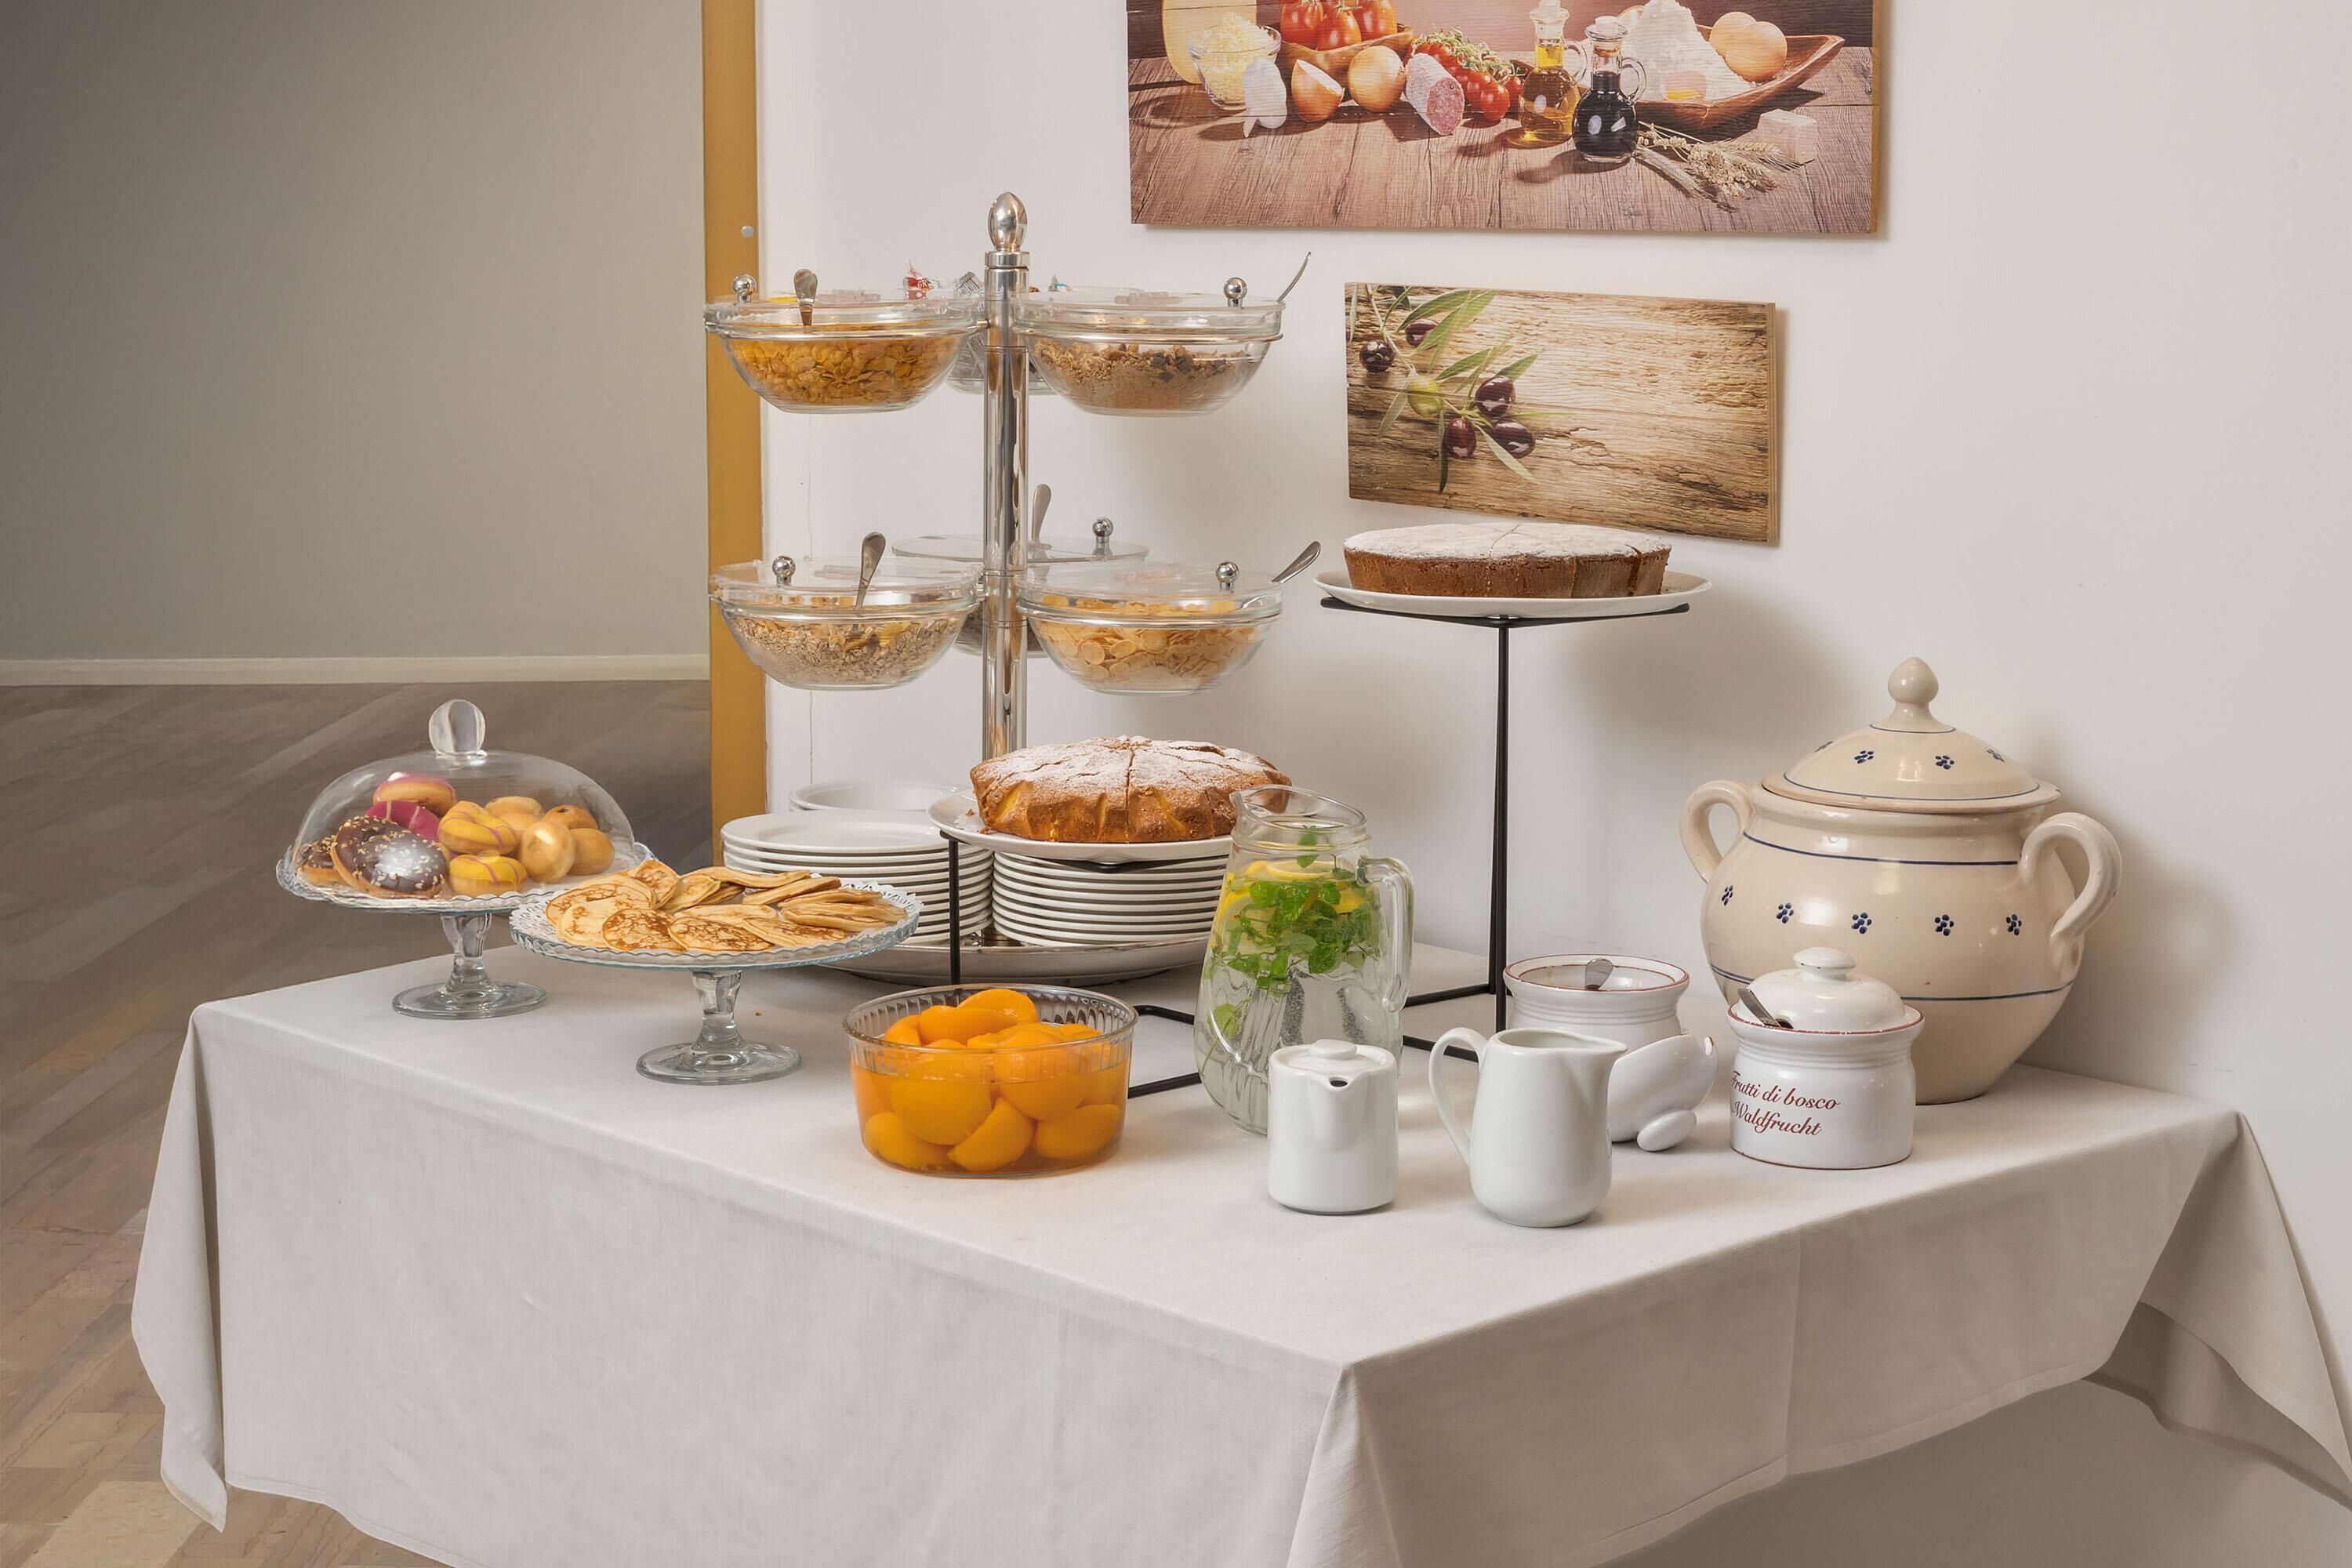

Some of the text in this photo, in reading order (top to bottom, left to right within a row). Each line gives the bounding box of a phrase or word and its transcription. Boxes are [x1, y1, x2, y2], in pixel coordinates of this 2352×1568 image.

[1731, 1070, 1840, 1109] Frutti di bosco
[1732, 1101, 1822, 1136] Waldfrucht
